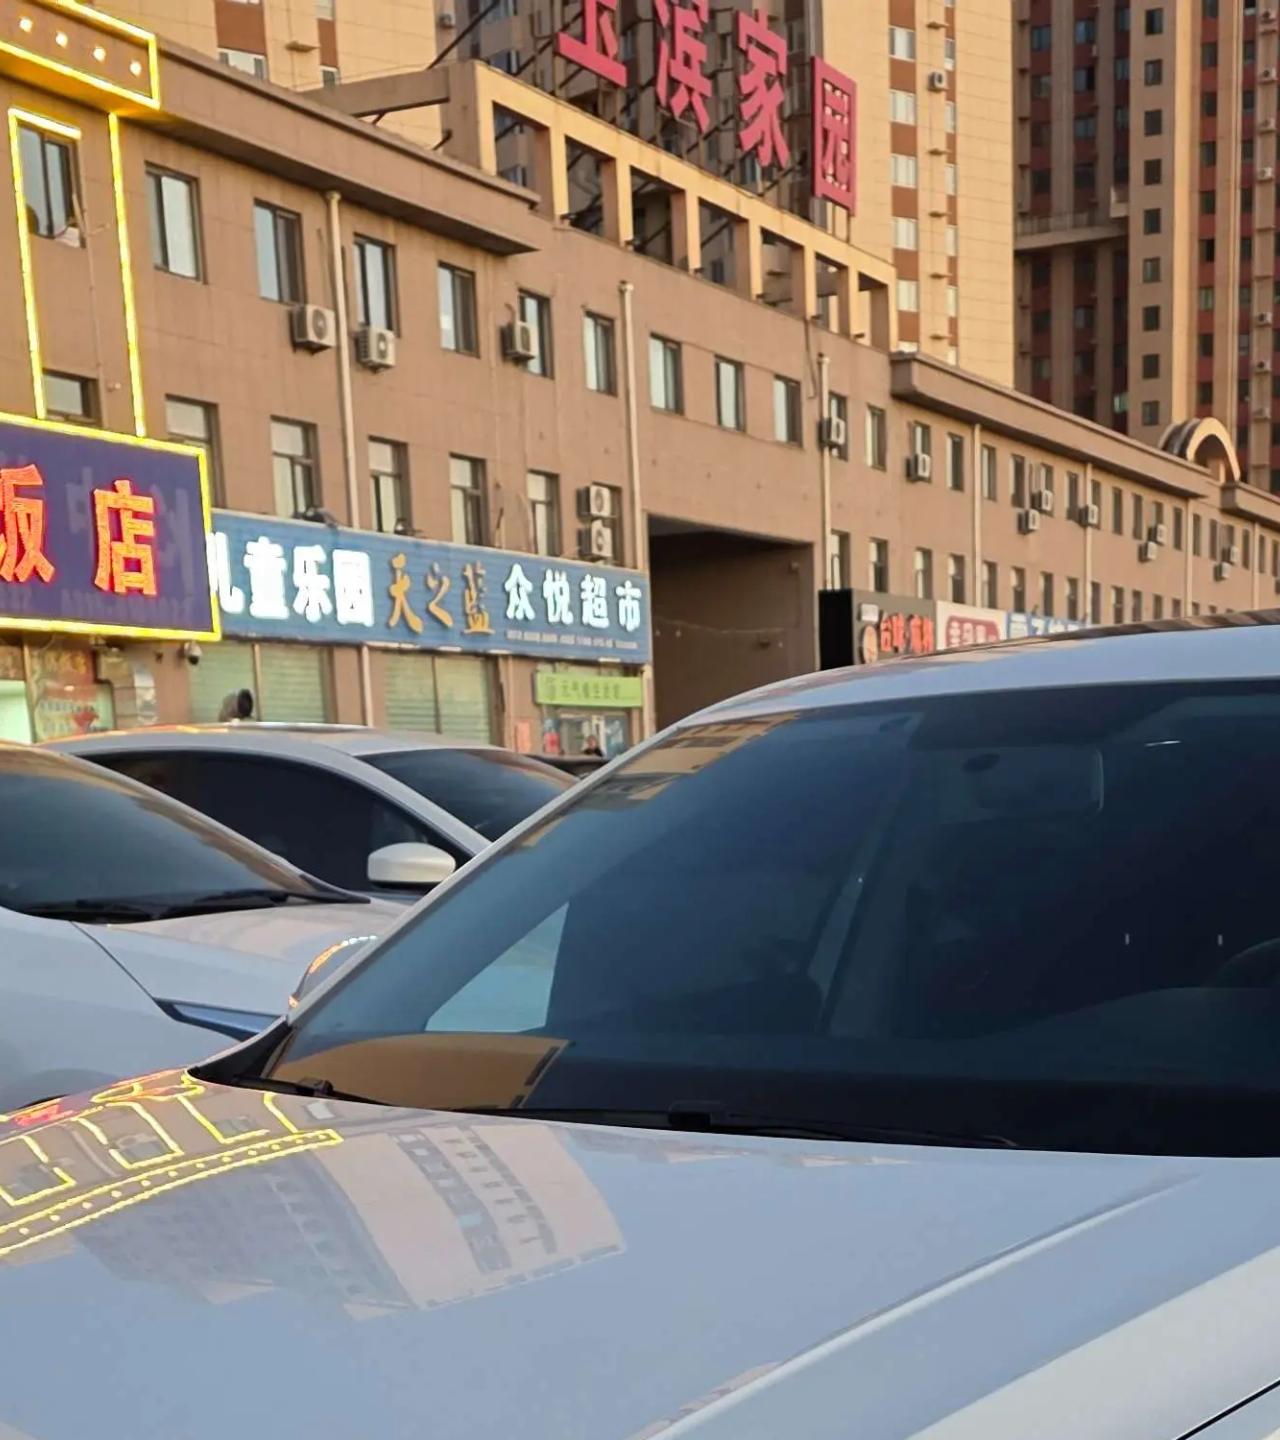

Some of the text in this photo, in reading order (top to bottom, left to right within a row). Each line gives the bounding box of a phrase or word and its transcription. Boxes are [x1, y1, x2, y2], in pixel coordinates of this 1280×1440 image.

[206, 531, 375, 628] 儿童乐园
[504, 562, 642, 632] 众悦超市
